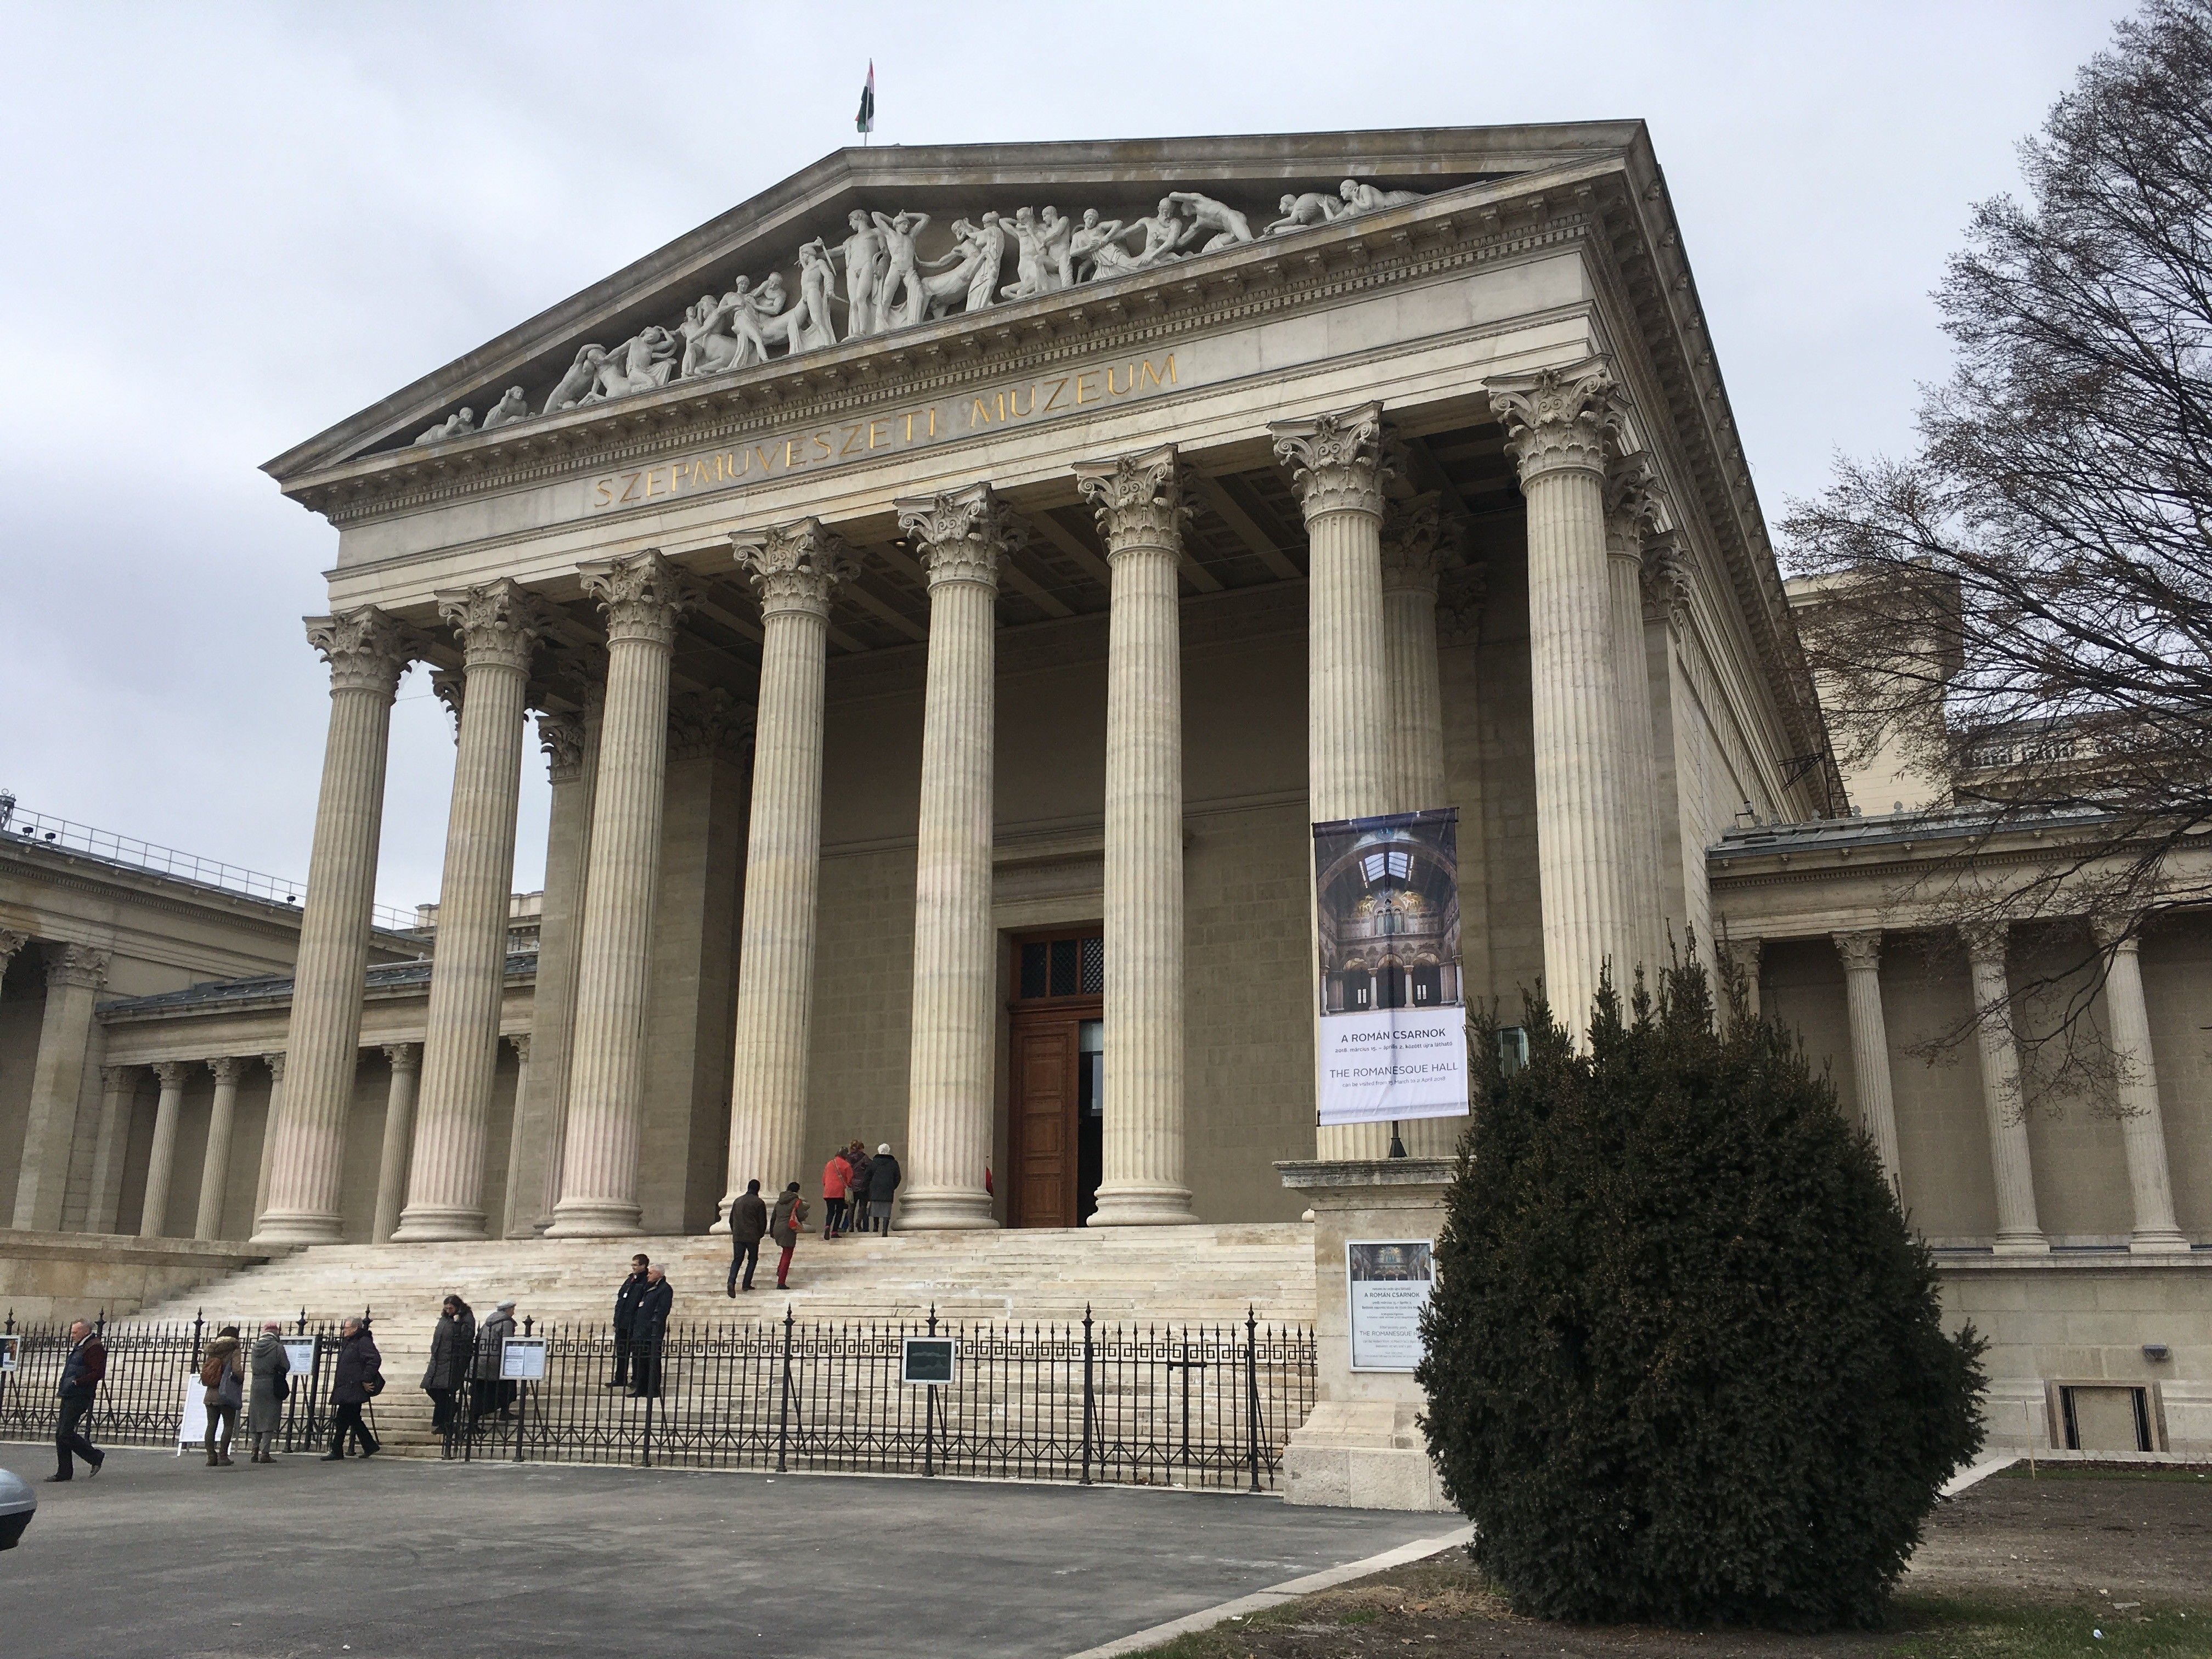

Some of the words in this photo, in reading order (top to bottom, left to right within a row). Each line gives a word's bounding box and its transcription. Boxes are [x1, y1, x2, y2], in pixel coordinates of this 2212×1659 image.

[1341, 1034, 1348, 1043] A
[1351, 1030, 1390, 1042] ROMÁN
[1393, 1028, 1446, 1040] CSARNOK
[1329, 1069, 1350, 1078] THE
[1353, 1064, 1428, 1077] ROMANESQUE
[1431, 1062, 1459, 1072] HALL
